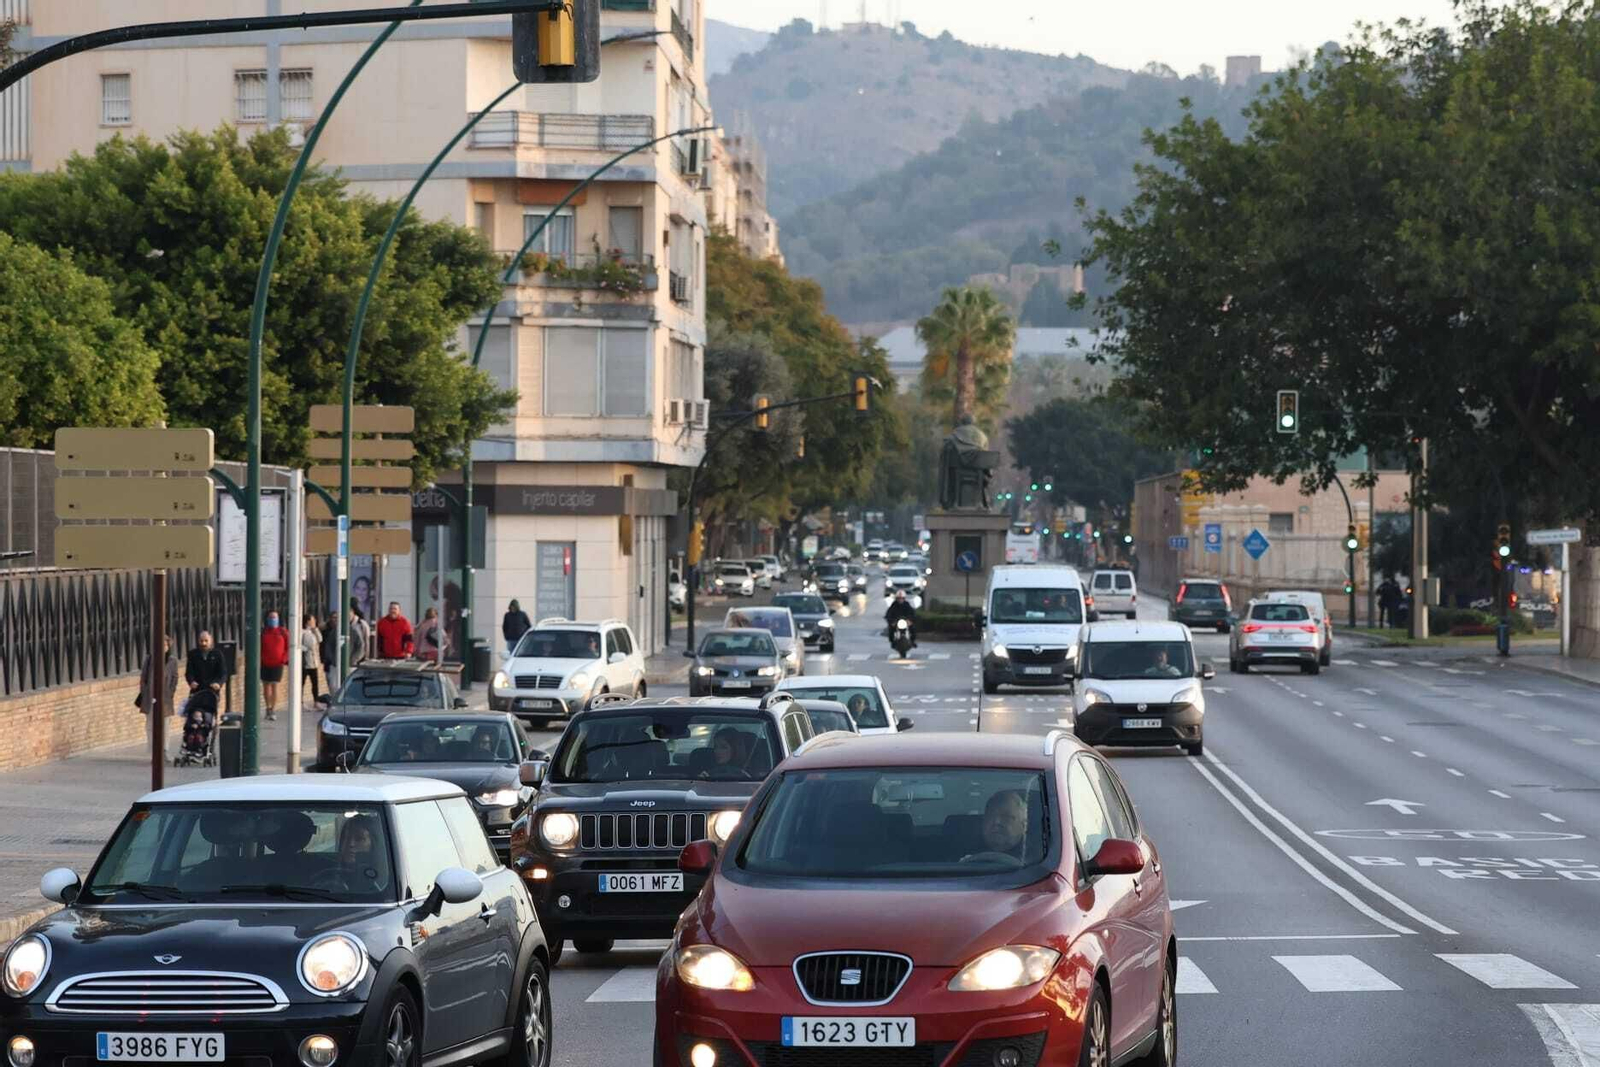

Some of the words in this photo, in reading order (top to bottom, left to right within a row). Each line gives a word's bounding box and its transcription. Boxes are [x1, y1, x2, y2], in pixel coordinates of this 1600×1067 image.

[522, 489, 557, 511] Injerto
[560, 489, 596, 511] capilar
[630, 800, 656, 808] Jeep
[609, 875, 646, 890] 0061
[651, 875, 680, 890] MFZ
[801, 1022, 857, 1043] 1623
[865, 1022, 908, 1043] GTY
[112, 1037, 168, 1058] 3986
[175, 1037, 218, 1058] FYG
